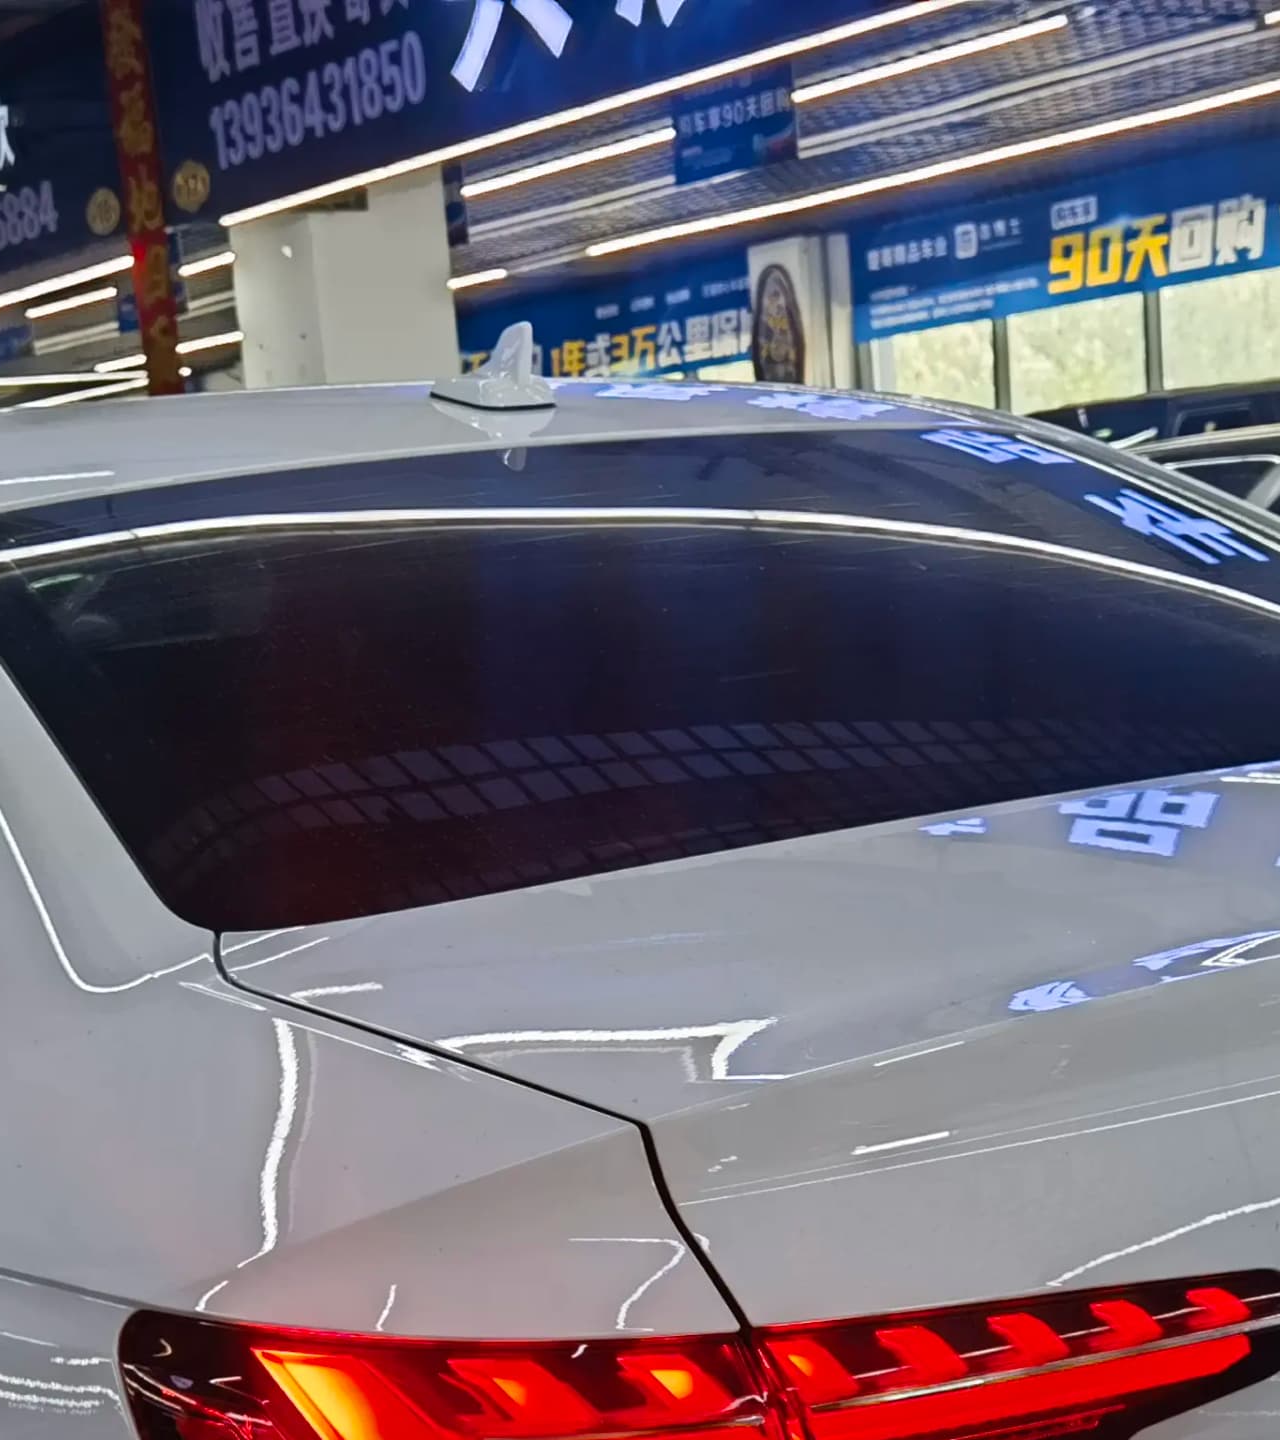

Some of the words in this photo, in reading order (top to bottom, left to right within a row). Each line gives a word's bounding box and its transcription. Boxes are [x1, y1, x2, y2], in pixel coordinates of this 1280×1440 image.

[209, 29, 427, 171] 13936431850
[1047, 194, 1268, 295] 90天回购
[550, 308, 753, 378] 1年或3万公里保
